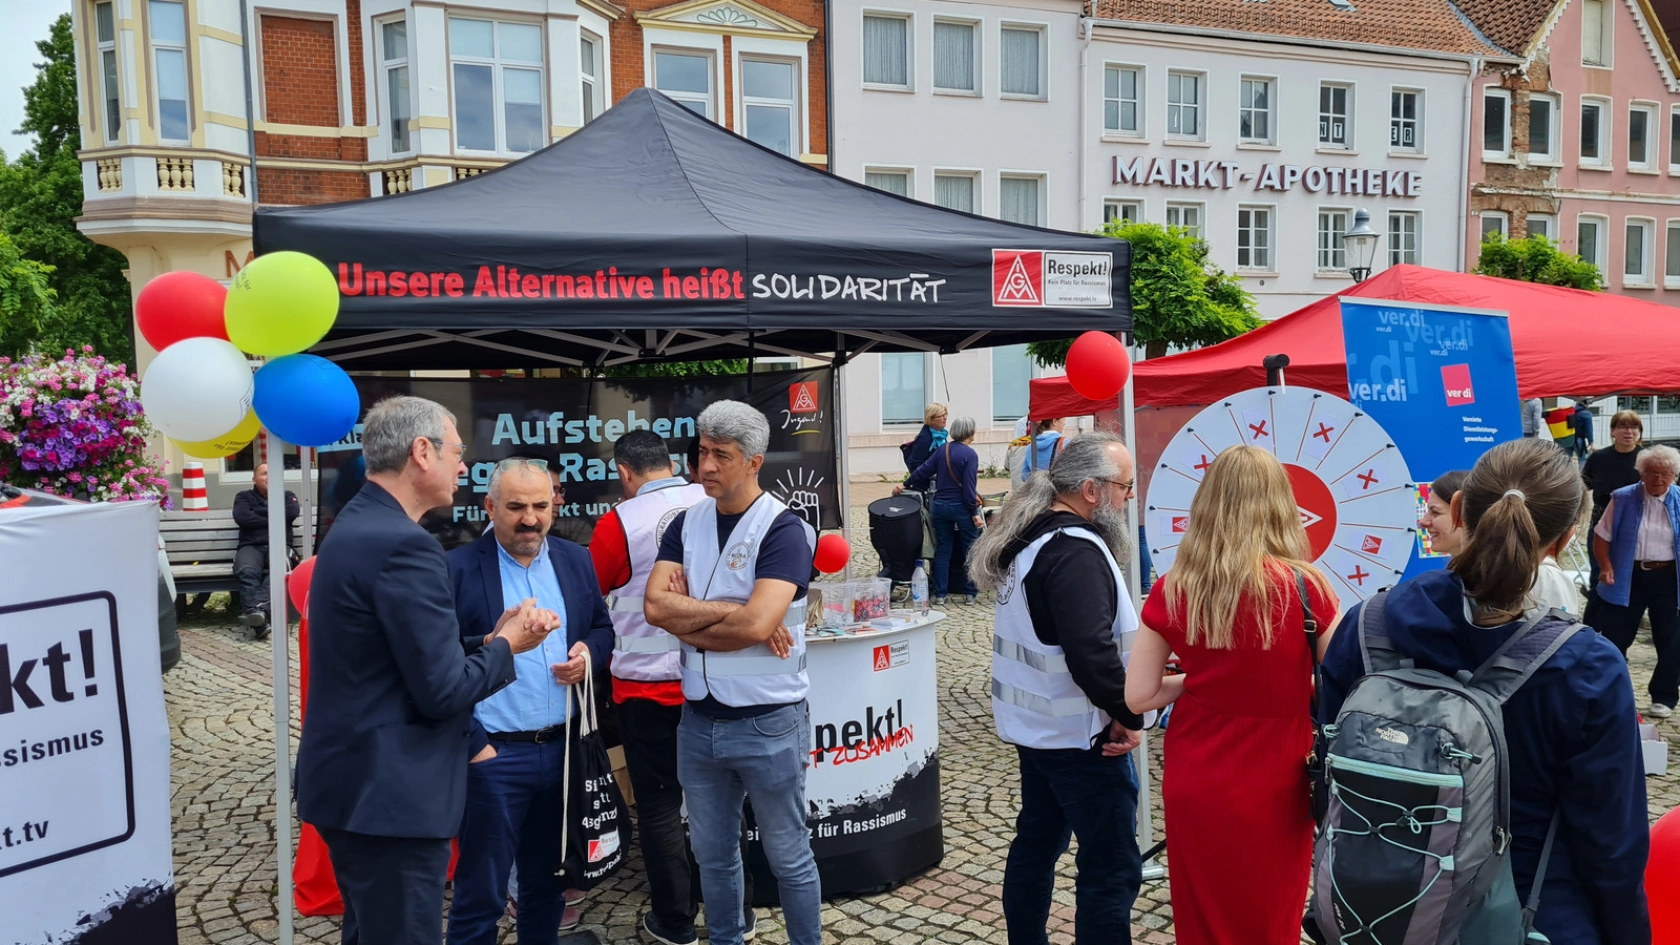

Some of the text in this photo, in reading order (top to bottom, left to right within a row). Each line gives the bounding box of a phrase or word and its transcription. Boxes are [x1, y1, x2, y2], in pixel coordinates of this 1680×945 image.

[338, 262, 464, 297] Unsere
[472, 265, 654, 299] Alternative
[662, 266, 744, 299] heißt
[1048, 259, 1107, 277] Respekt!
[1378, 310, 1425, 328] ver.di
[1348, 379, 1407, 402] ver.di
[815, 698, 903, 763] pekt!
[829, 723, 914, 767] ZUSAMMEN
[818, 823, 839, 838] für
[843, 808, 907, 835] Rassismus
